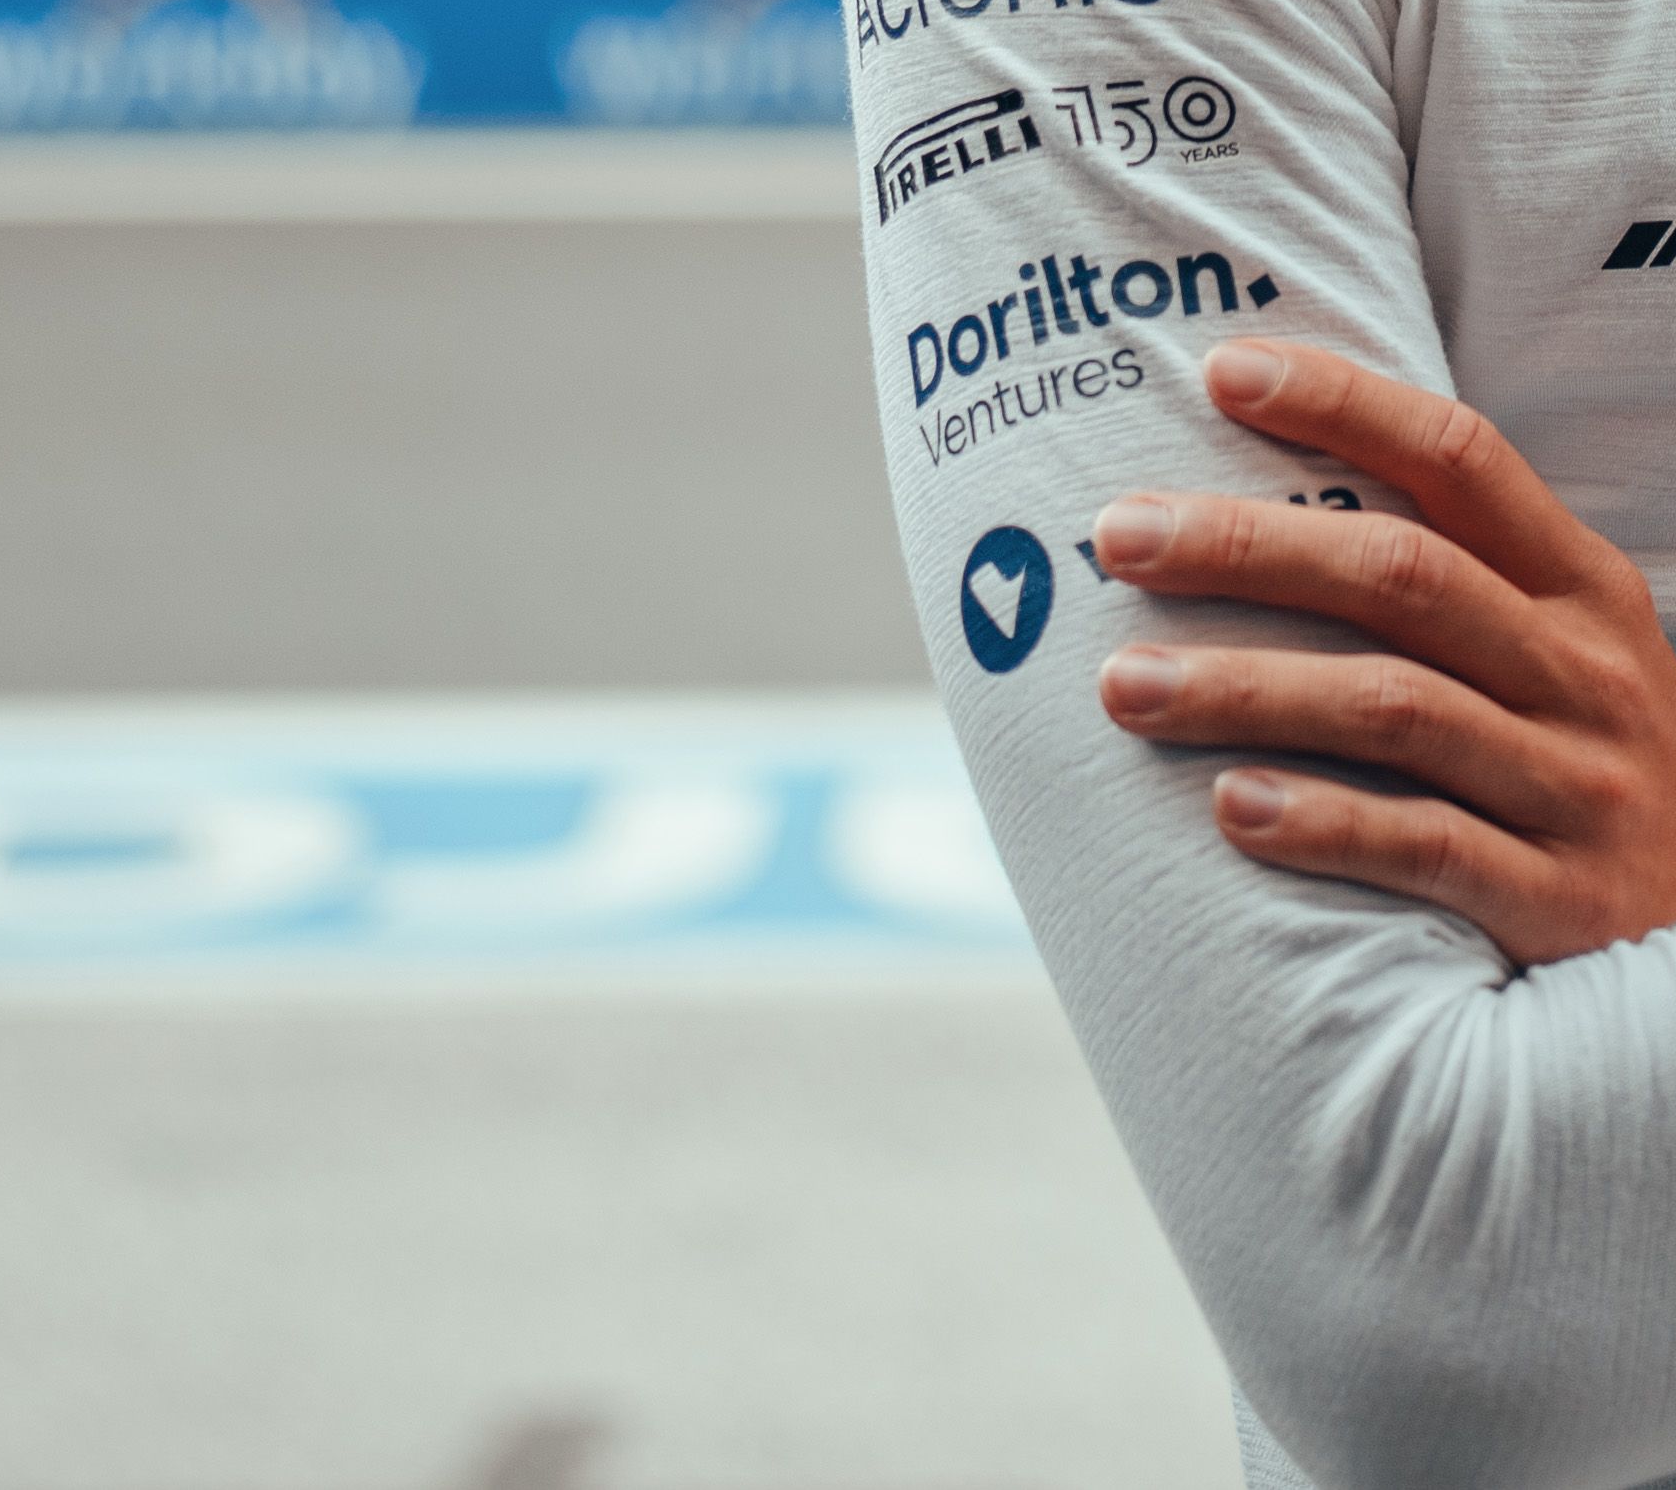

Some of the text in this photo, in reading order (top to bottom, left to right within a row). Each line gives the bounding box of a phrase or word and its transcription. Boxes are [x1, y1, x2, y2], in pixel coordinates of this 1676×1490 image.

[874, 87, 1043, 226] PIRELLI
[1180, 142, 1240, 165] YEARS
[919, 347, 1147, 468] Ventures
